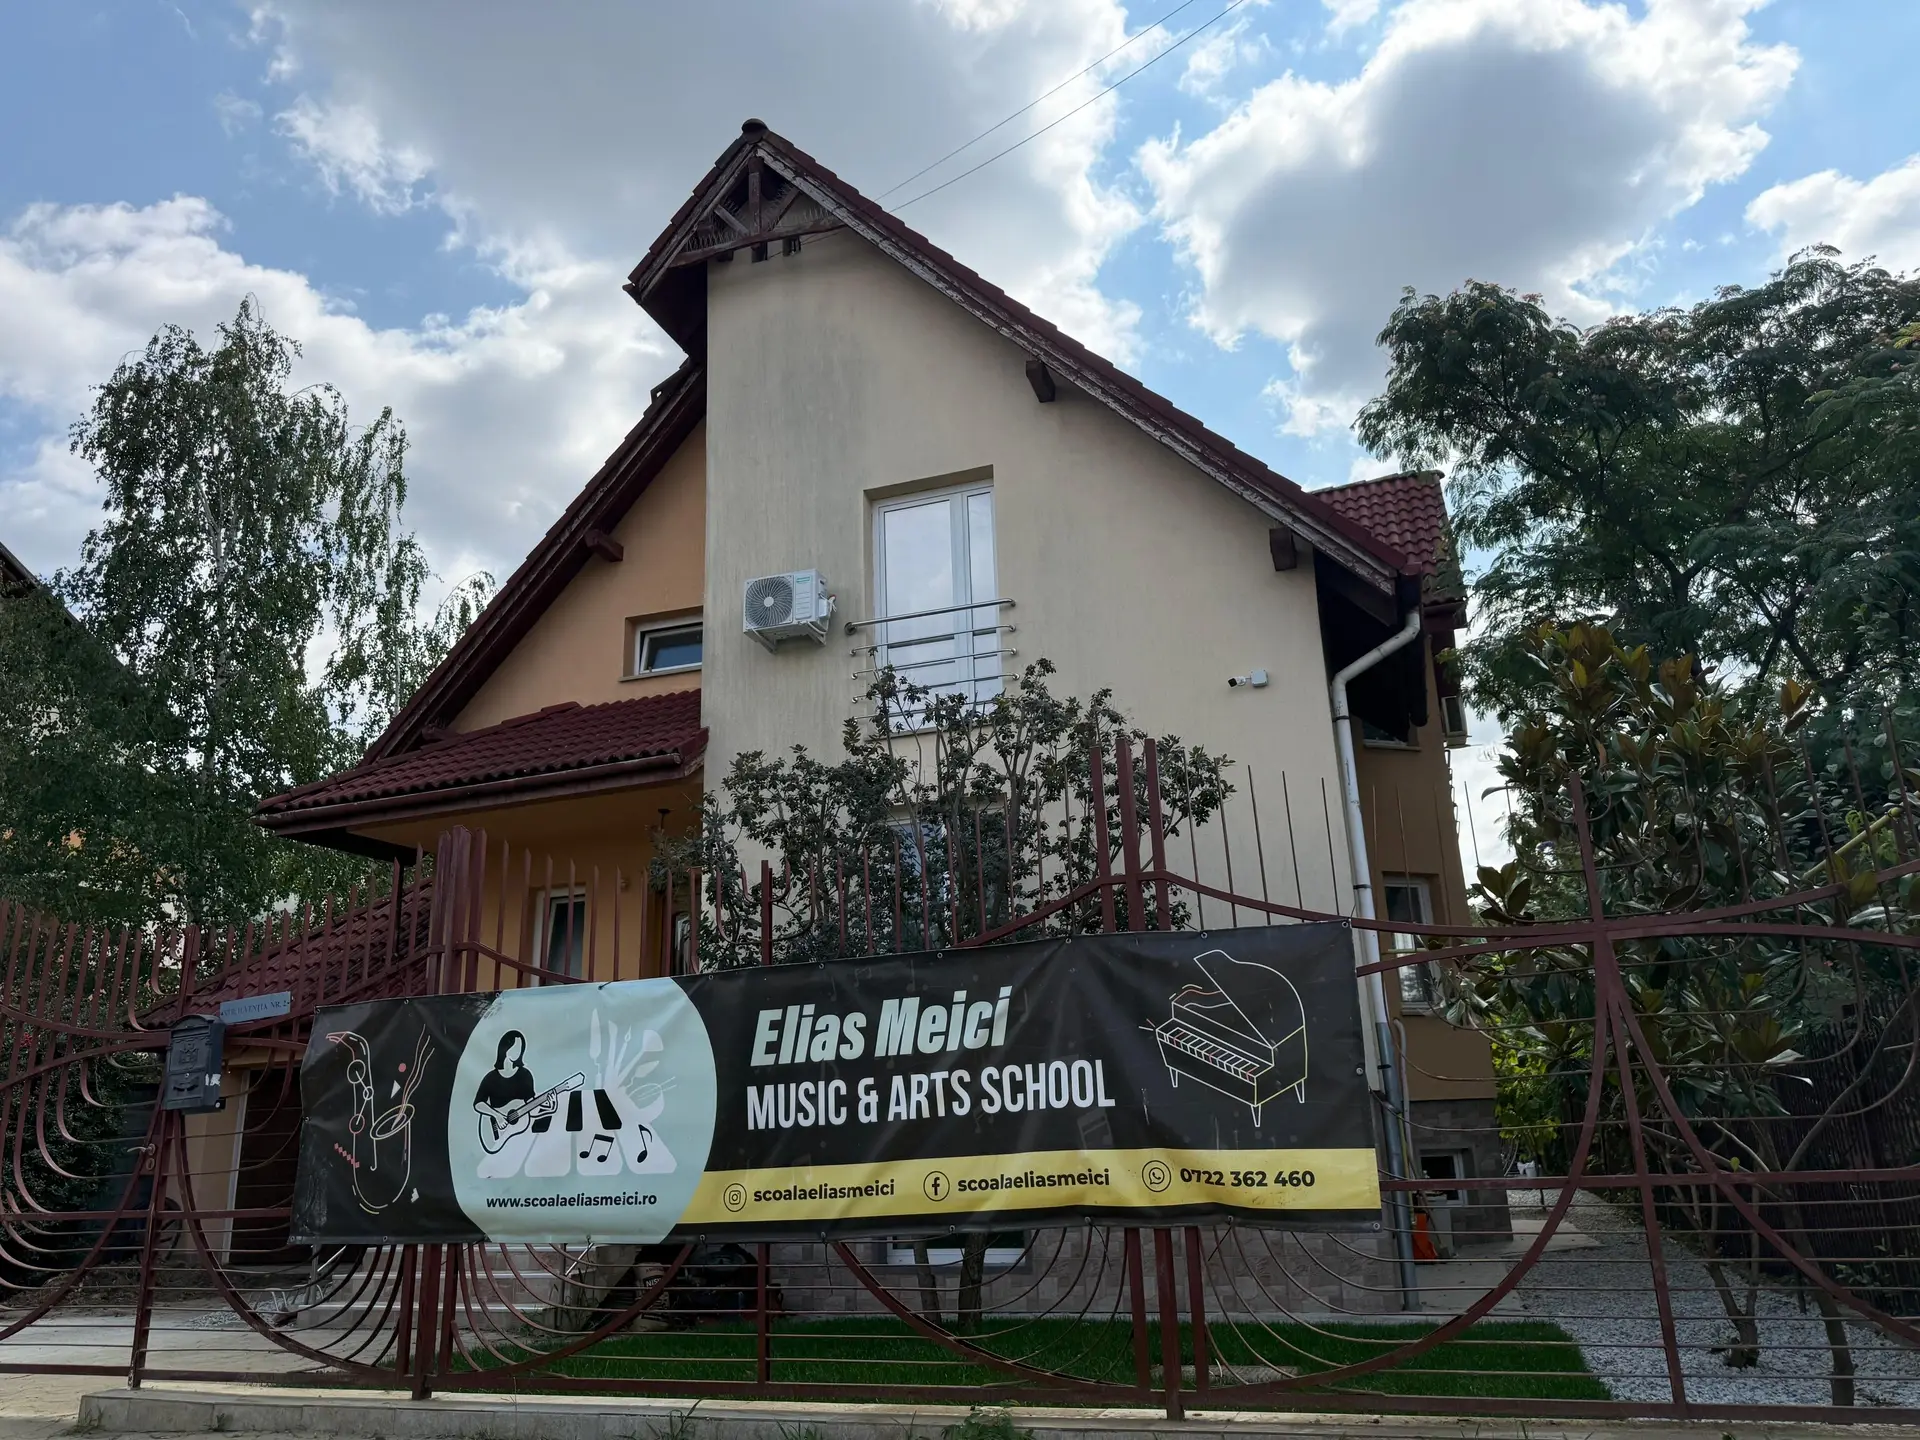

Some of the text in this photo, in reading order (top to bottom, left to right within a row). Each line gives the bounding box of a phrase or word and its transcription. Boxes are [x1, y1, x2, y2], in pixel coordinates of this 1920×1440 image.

[750, 985, 1013, 1067] Elias Meici
[747, 1059, 1116, 1130] MUSIC & ARTS SCHOOL
[957, 1168, 1110, 1192] scoalaeliasmeici
[1180, 1168, 1315, 1187] 0722 362 460
[486, 1191, 658, 1208] www.scoalaeliasmeici.ro
[753, 1179, 895, 1203] scoalaeliasmeici
